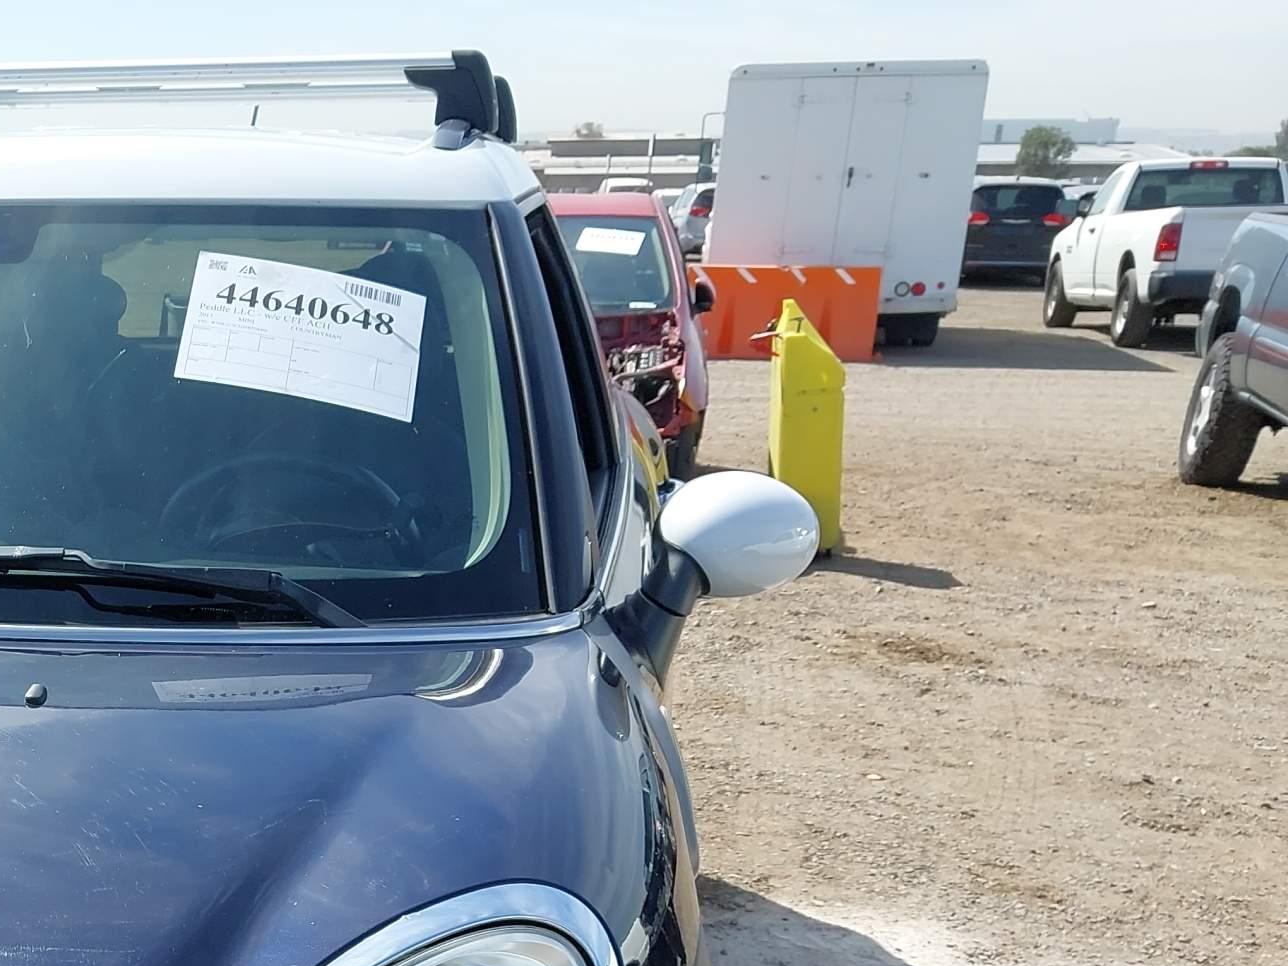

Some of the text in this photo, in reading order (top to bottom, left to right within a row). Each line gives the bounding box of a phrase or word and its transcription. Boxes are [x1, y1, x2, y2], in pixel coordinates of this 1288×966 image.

[199, 302, 231, 314] Peddle
[232, 305, 255, 317] LLC
[216, 283, 395, 336] 44640648
